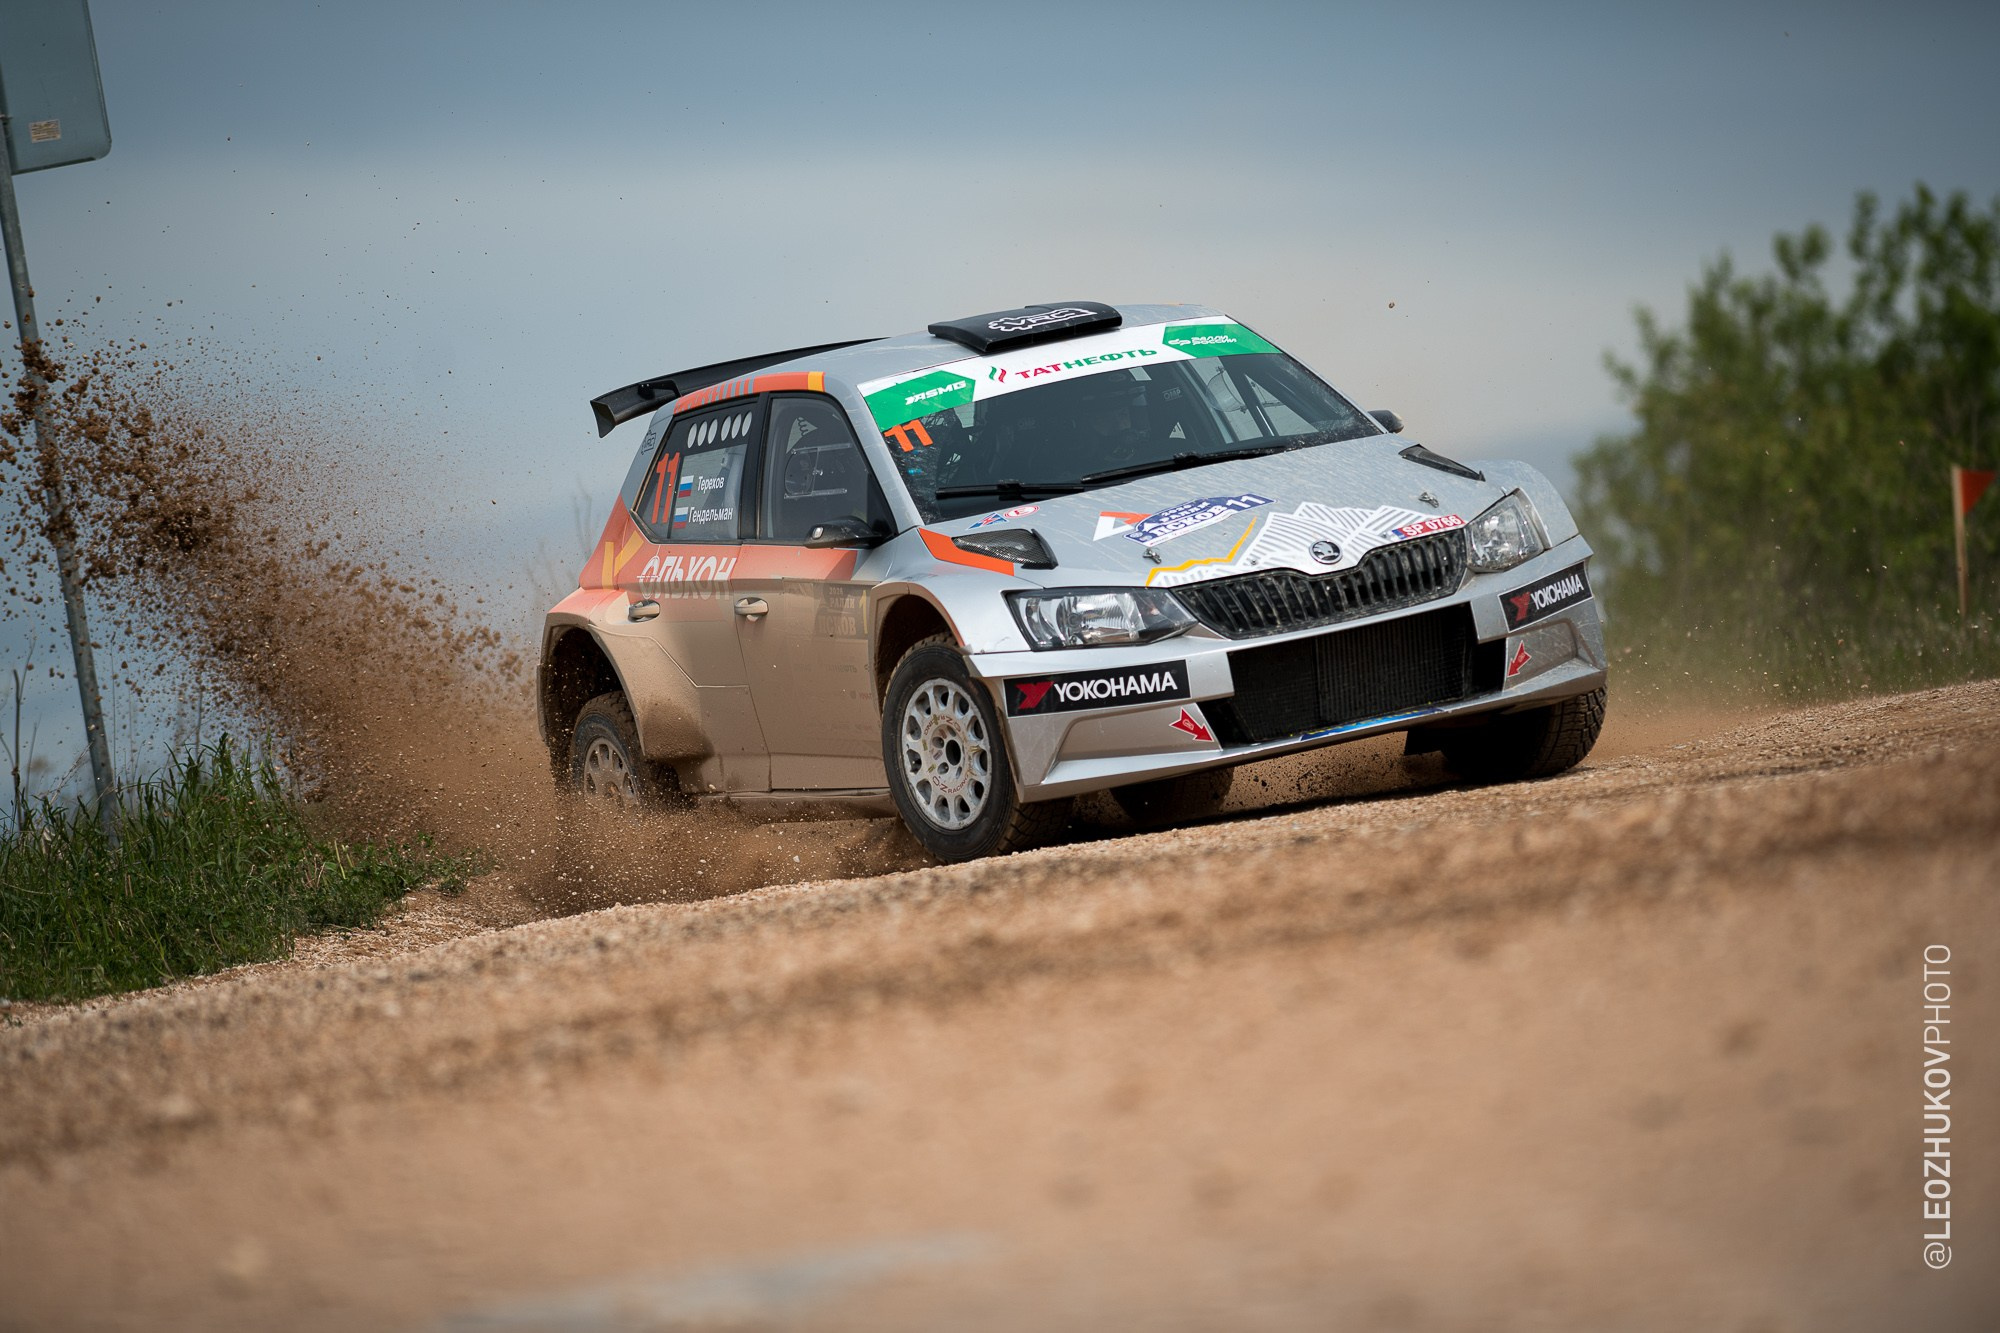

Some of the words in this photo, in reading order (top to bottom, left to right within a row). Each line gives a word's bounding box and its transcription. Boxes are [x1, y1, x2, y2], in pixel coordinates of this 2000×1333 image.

[1015, 349, 1157, 379] ТАТНЕФТЬ
[884, 418, 933, 453] 11
[651, 452, 680, 525] 11
[697, 476, 724, 494] Терехов
[688, 506, 733, 525] Гендельман
[1226, 495, 1266, 509] 11
[1149, 504, 1228, 536] ПСКОВ
[1402, 523, 1425, 536] SP
[1425, 515, 1462, 531] 0766
[638, 555, 737, 600] ОЛЬХОН
[1530, 573, 1585, 611] YOKOHAMA
[1054, 671, 1178, 703] YOKOHAMA
